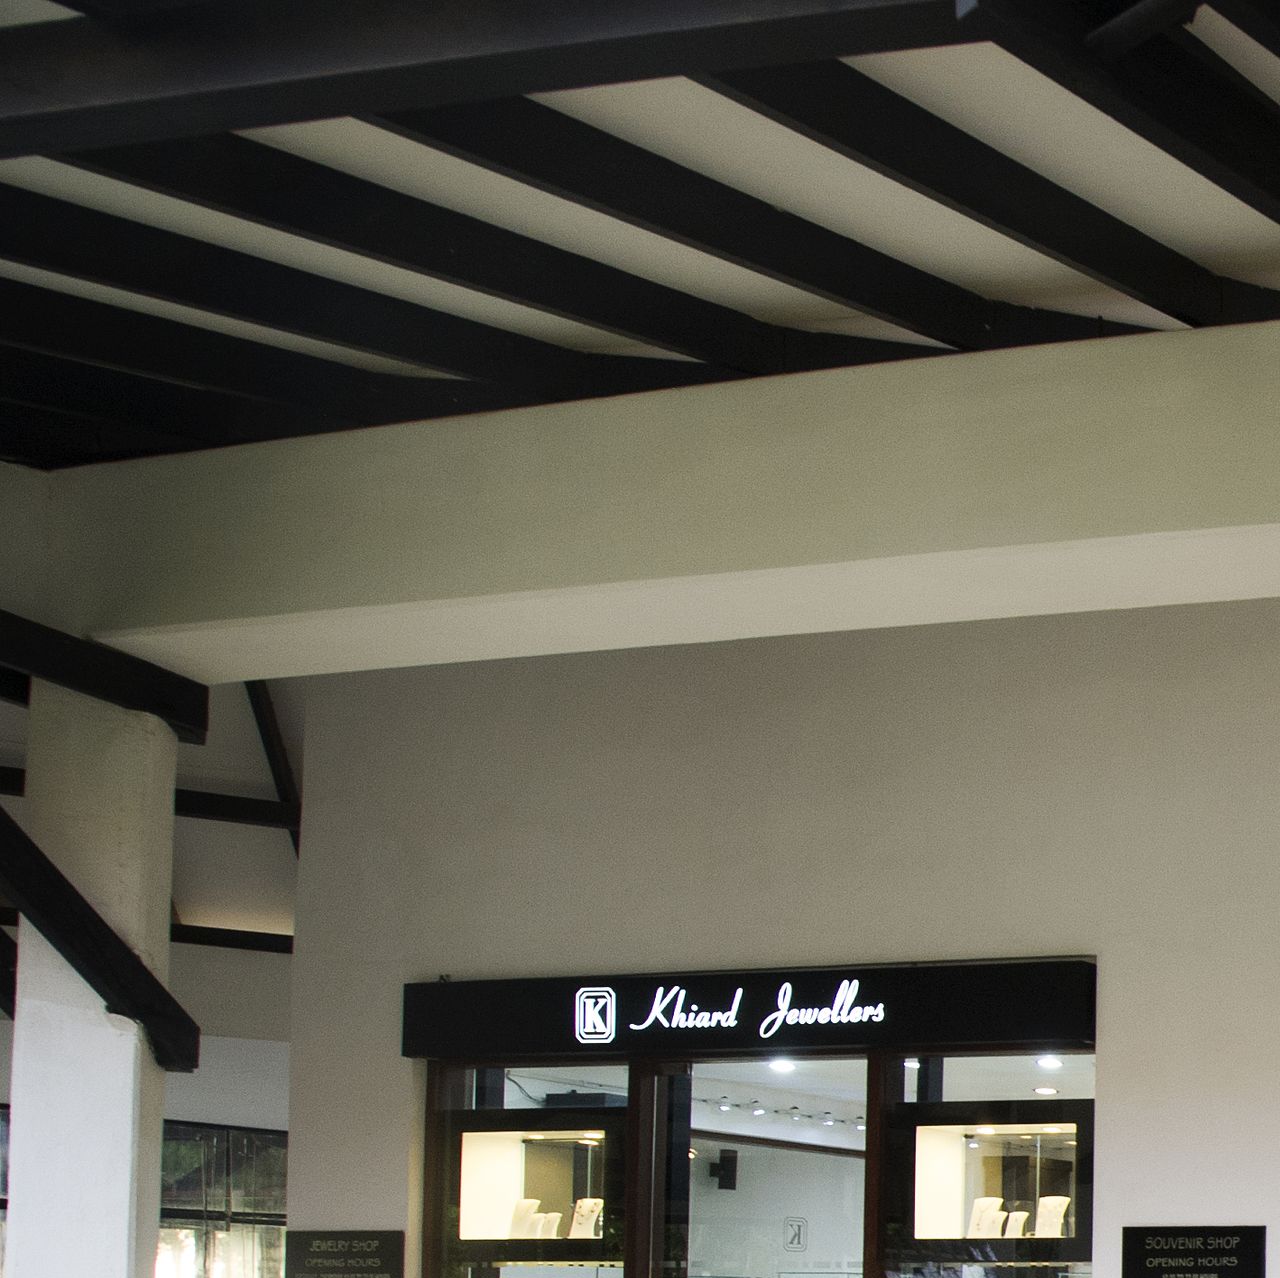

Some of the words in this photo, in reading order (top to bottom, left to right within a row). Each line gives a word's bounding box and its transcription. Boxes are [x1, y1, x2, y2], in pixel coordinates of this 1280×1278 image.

[629, 986, 743, 1030] Khiard
[759, 979, 885, 1039] Jewellers
[583, 998, 608, 1033] K
[309, 1240, 350, 1252] JEWELRY
[351, 1240, 380, 1252] SHOP
[1145, 1236, 1205, 1249] SOUVENIR
[1206, 1236, 1241, 1249] SHOP
[304, 1258, 345, 1268] OPENING
[346, 1258, 381, 1268] HOURS
[1145, 1257, 1195, 1268] OPENING
[1197, 1256, 1239, 1267] HOURS
